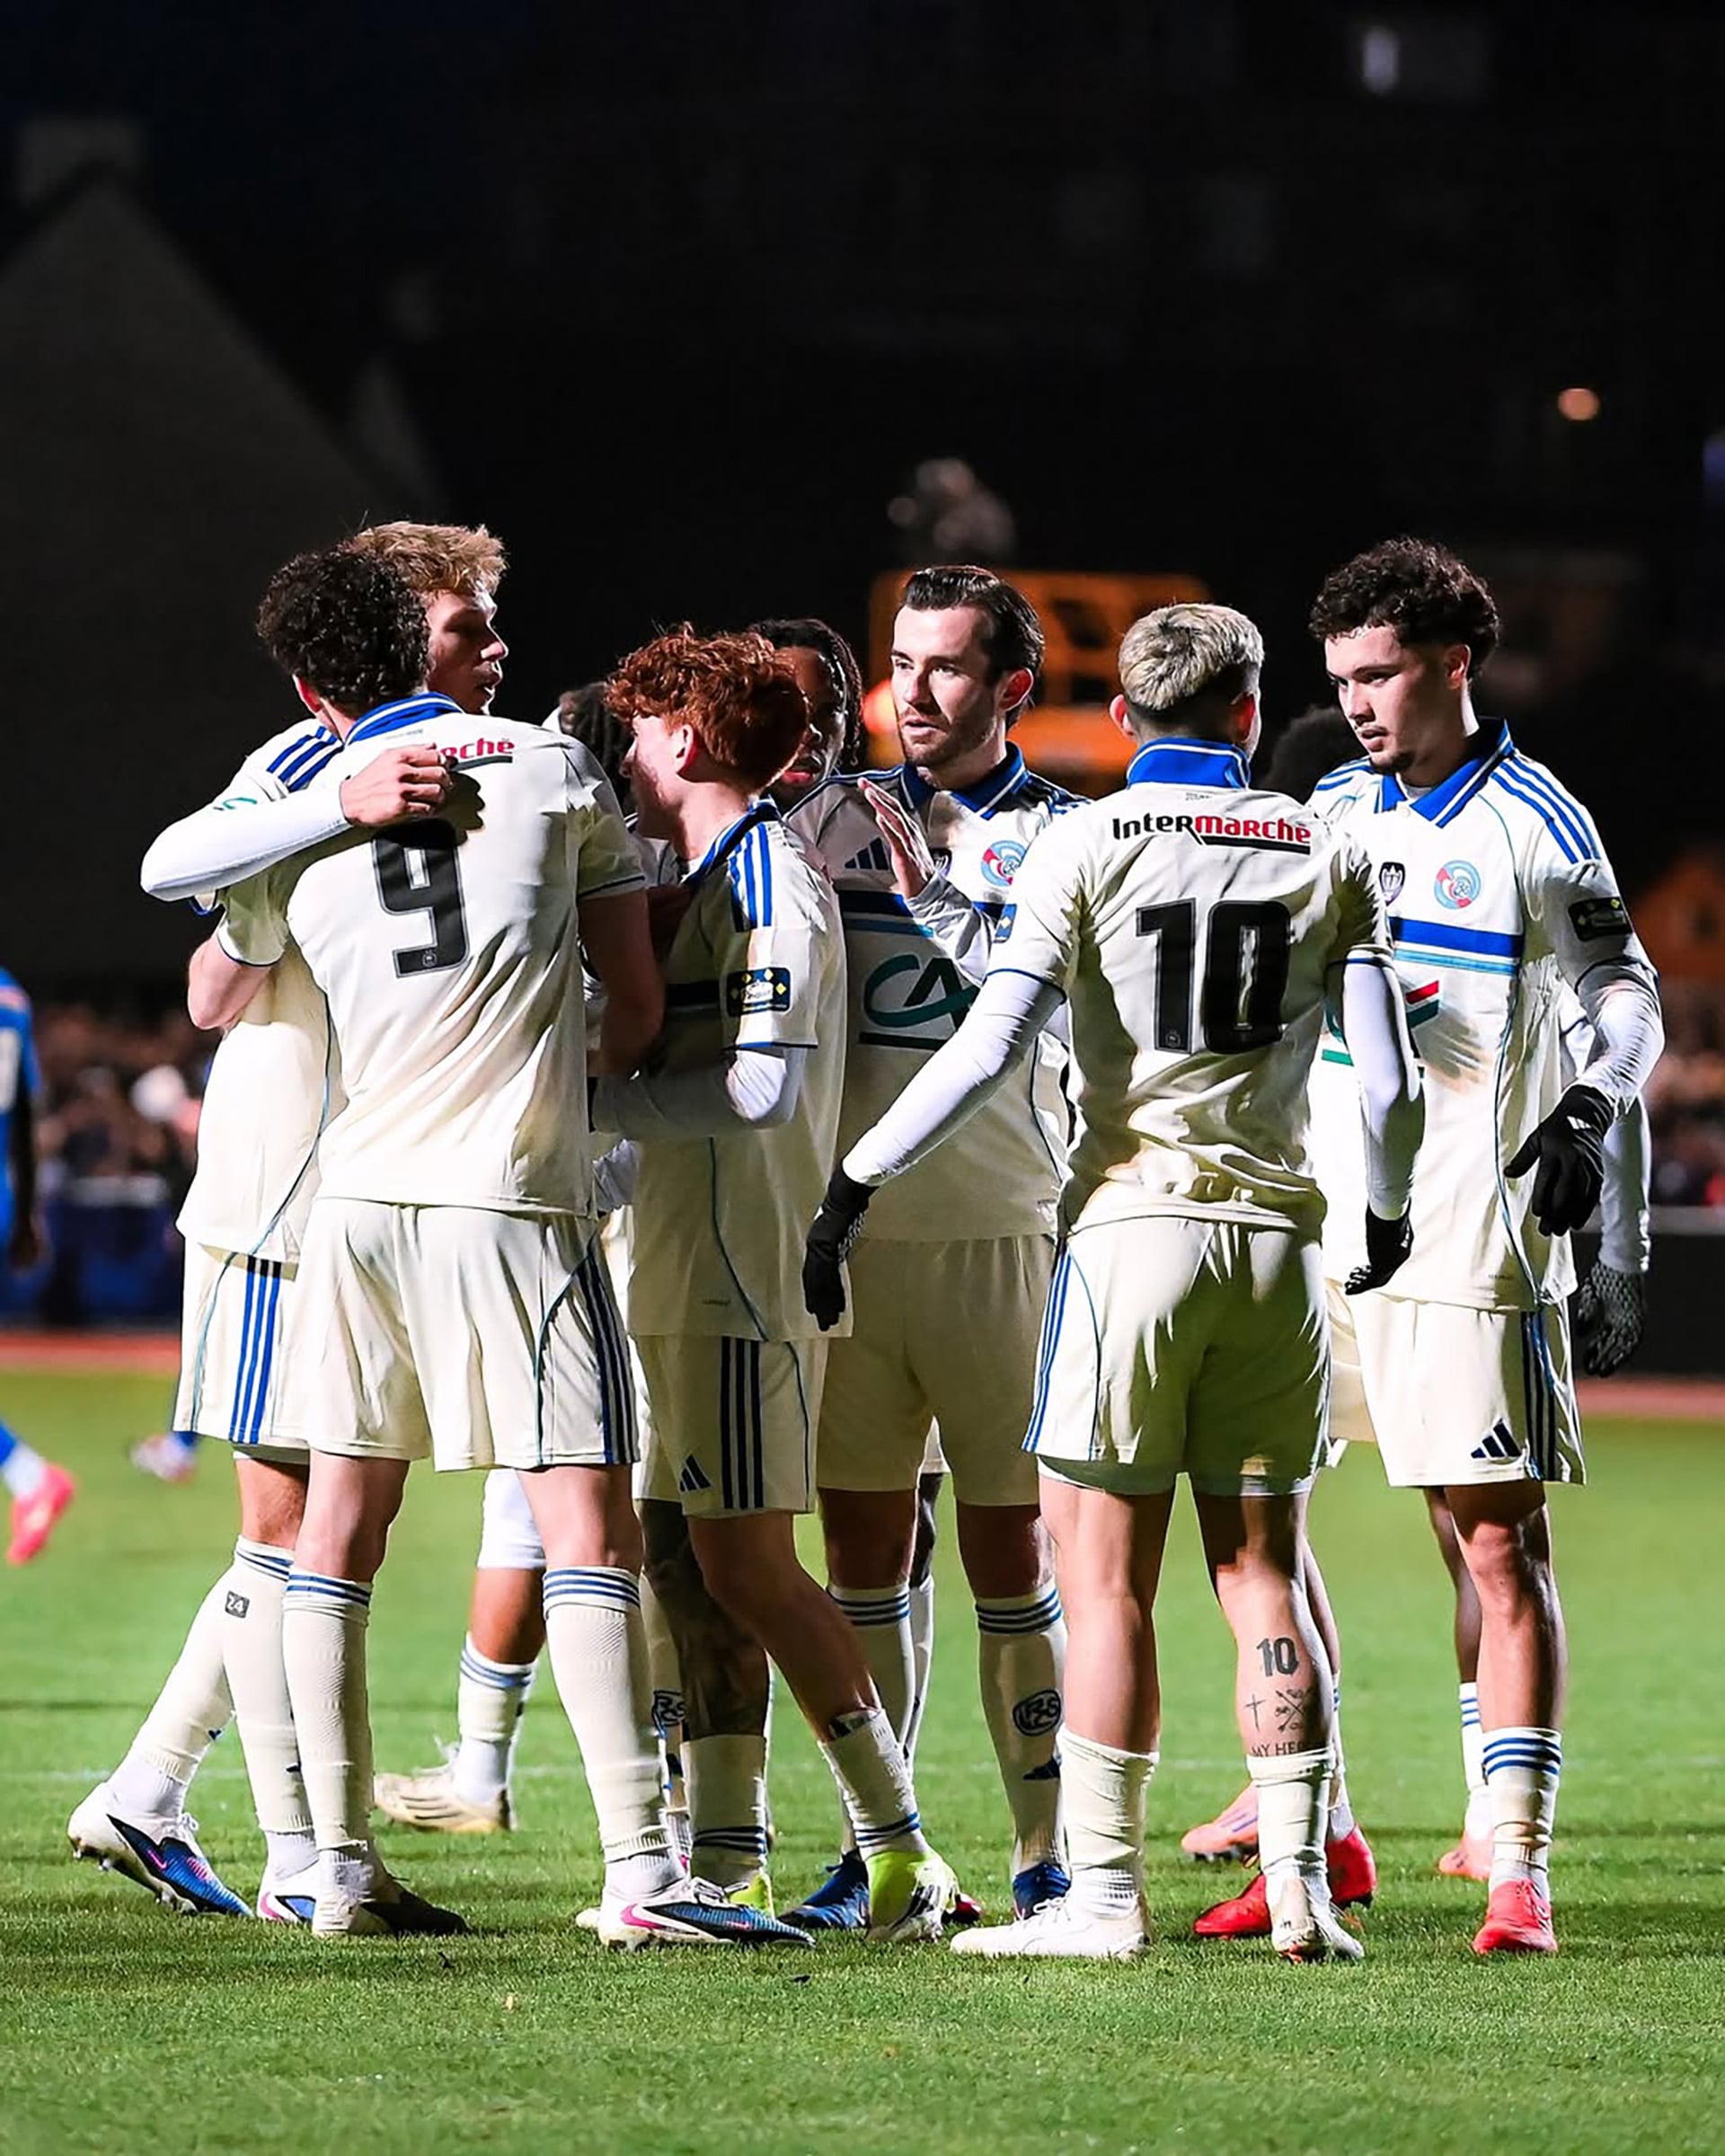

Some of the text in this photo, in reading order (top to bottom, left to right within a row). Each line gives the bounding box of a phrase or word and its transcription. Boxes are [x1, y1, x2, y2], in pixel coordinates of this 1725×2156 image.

[371, 816, 470, 978] 9
[1136, 897, 1291, 1055] 10
[1256, 1637, 1301, 1677] 10
